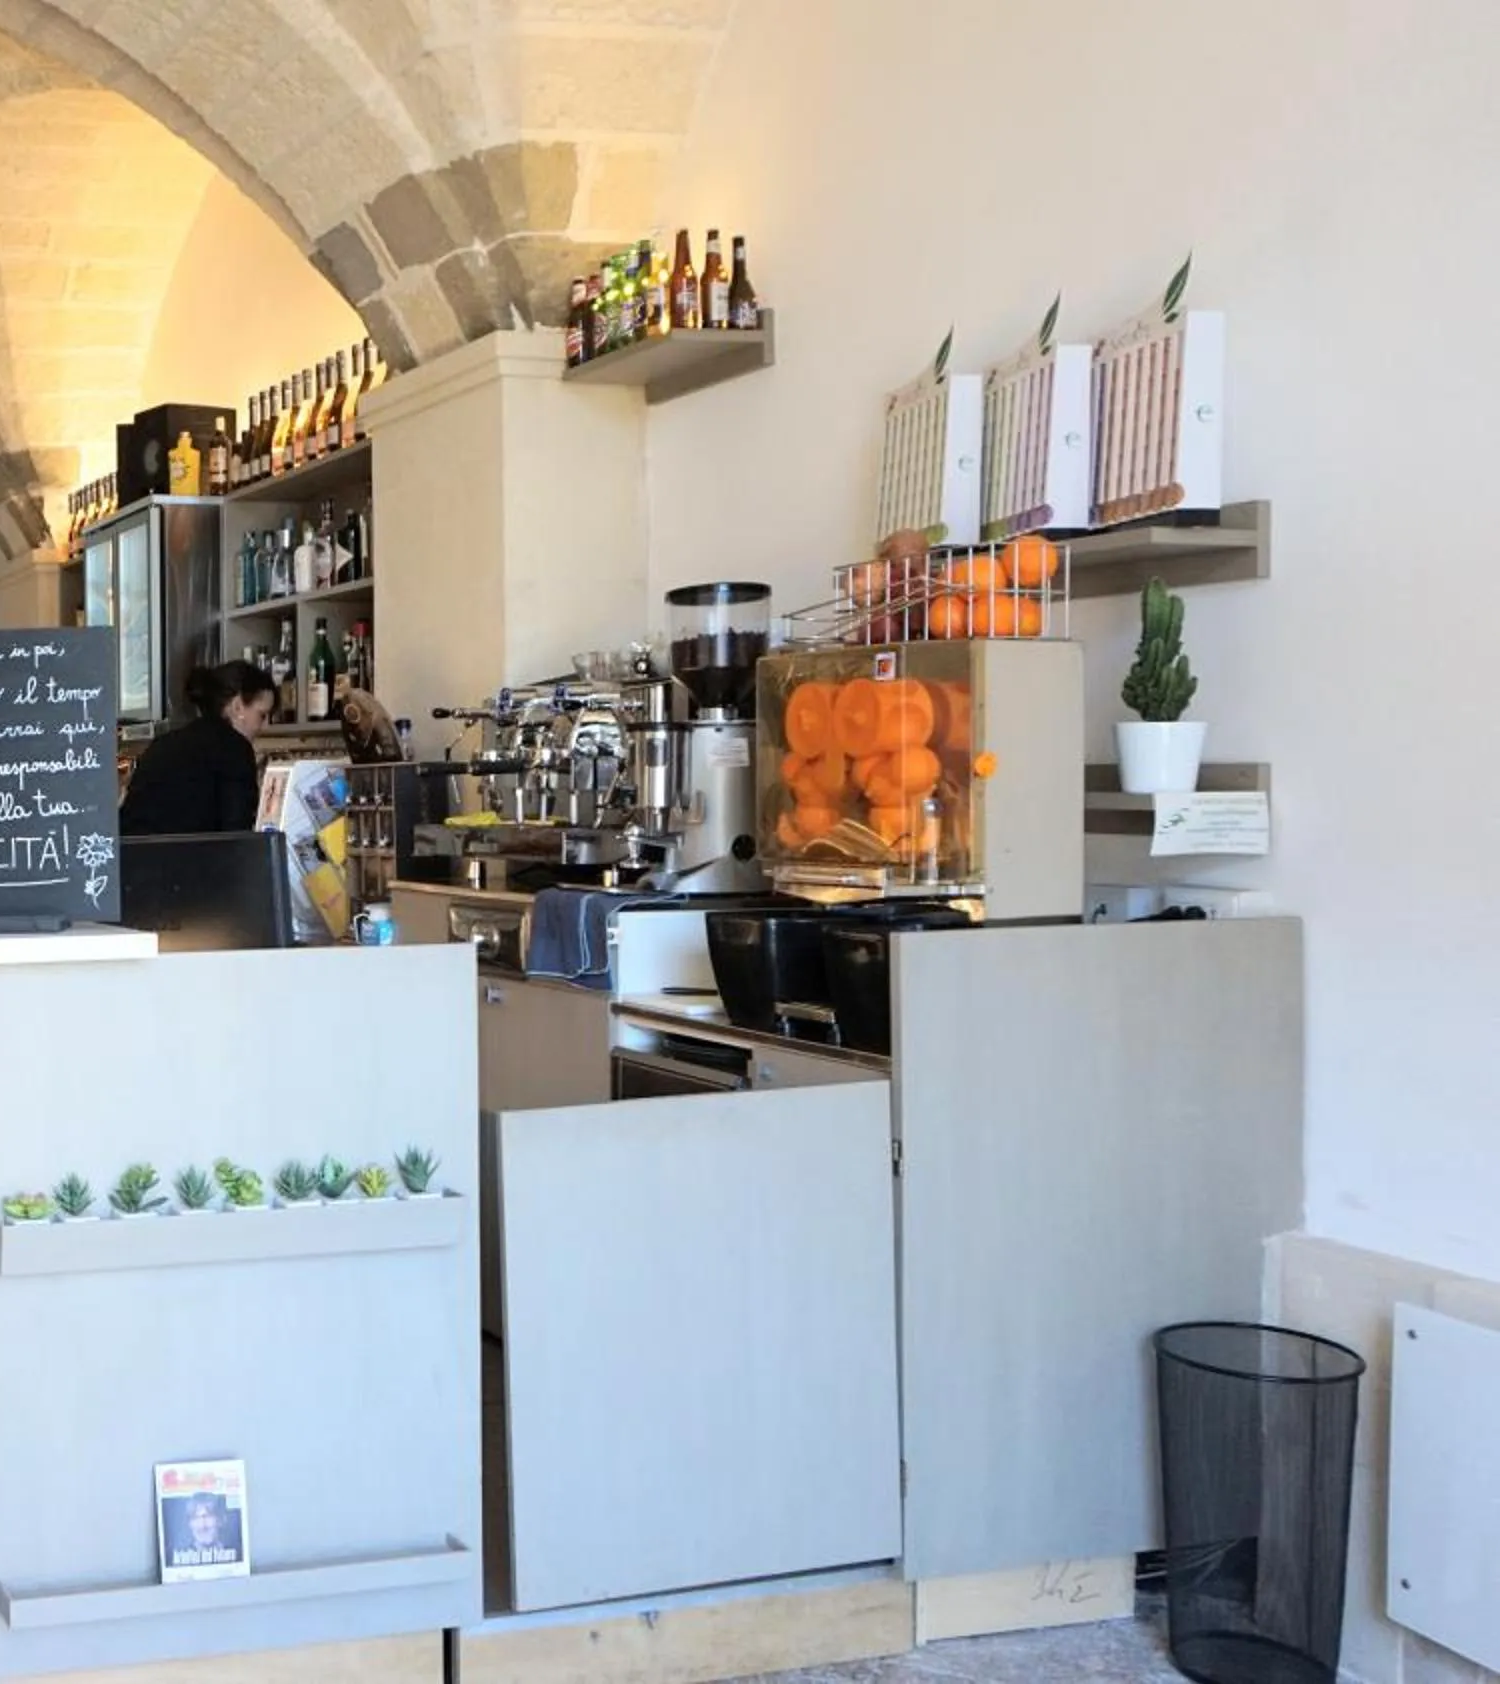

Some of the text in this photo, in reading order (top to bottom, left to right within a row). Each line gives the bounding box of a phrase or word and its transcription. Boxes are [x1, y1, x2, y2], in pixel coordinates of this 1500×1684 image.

[8, 642, 30, 658] in
[33, 641, 65, 669] poi,
[13, 675, 39, 705] il
[45, 676, 103, 721] tempo
